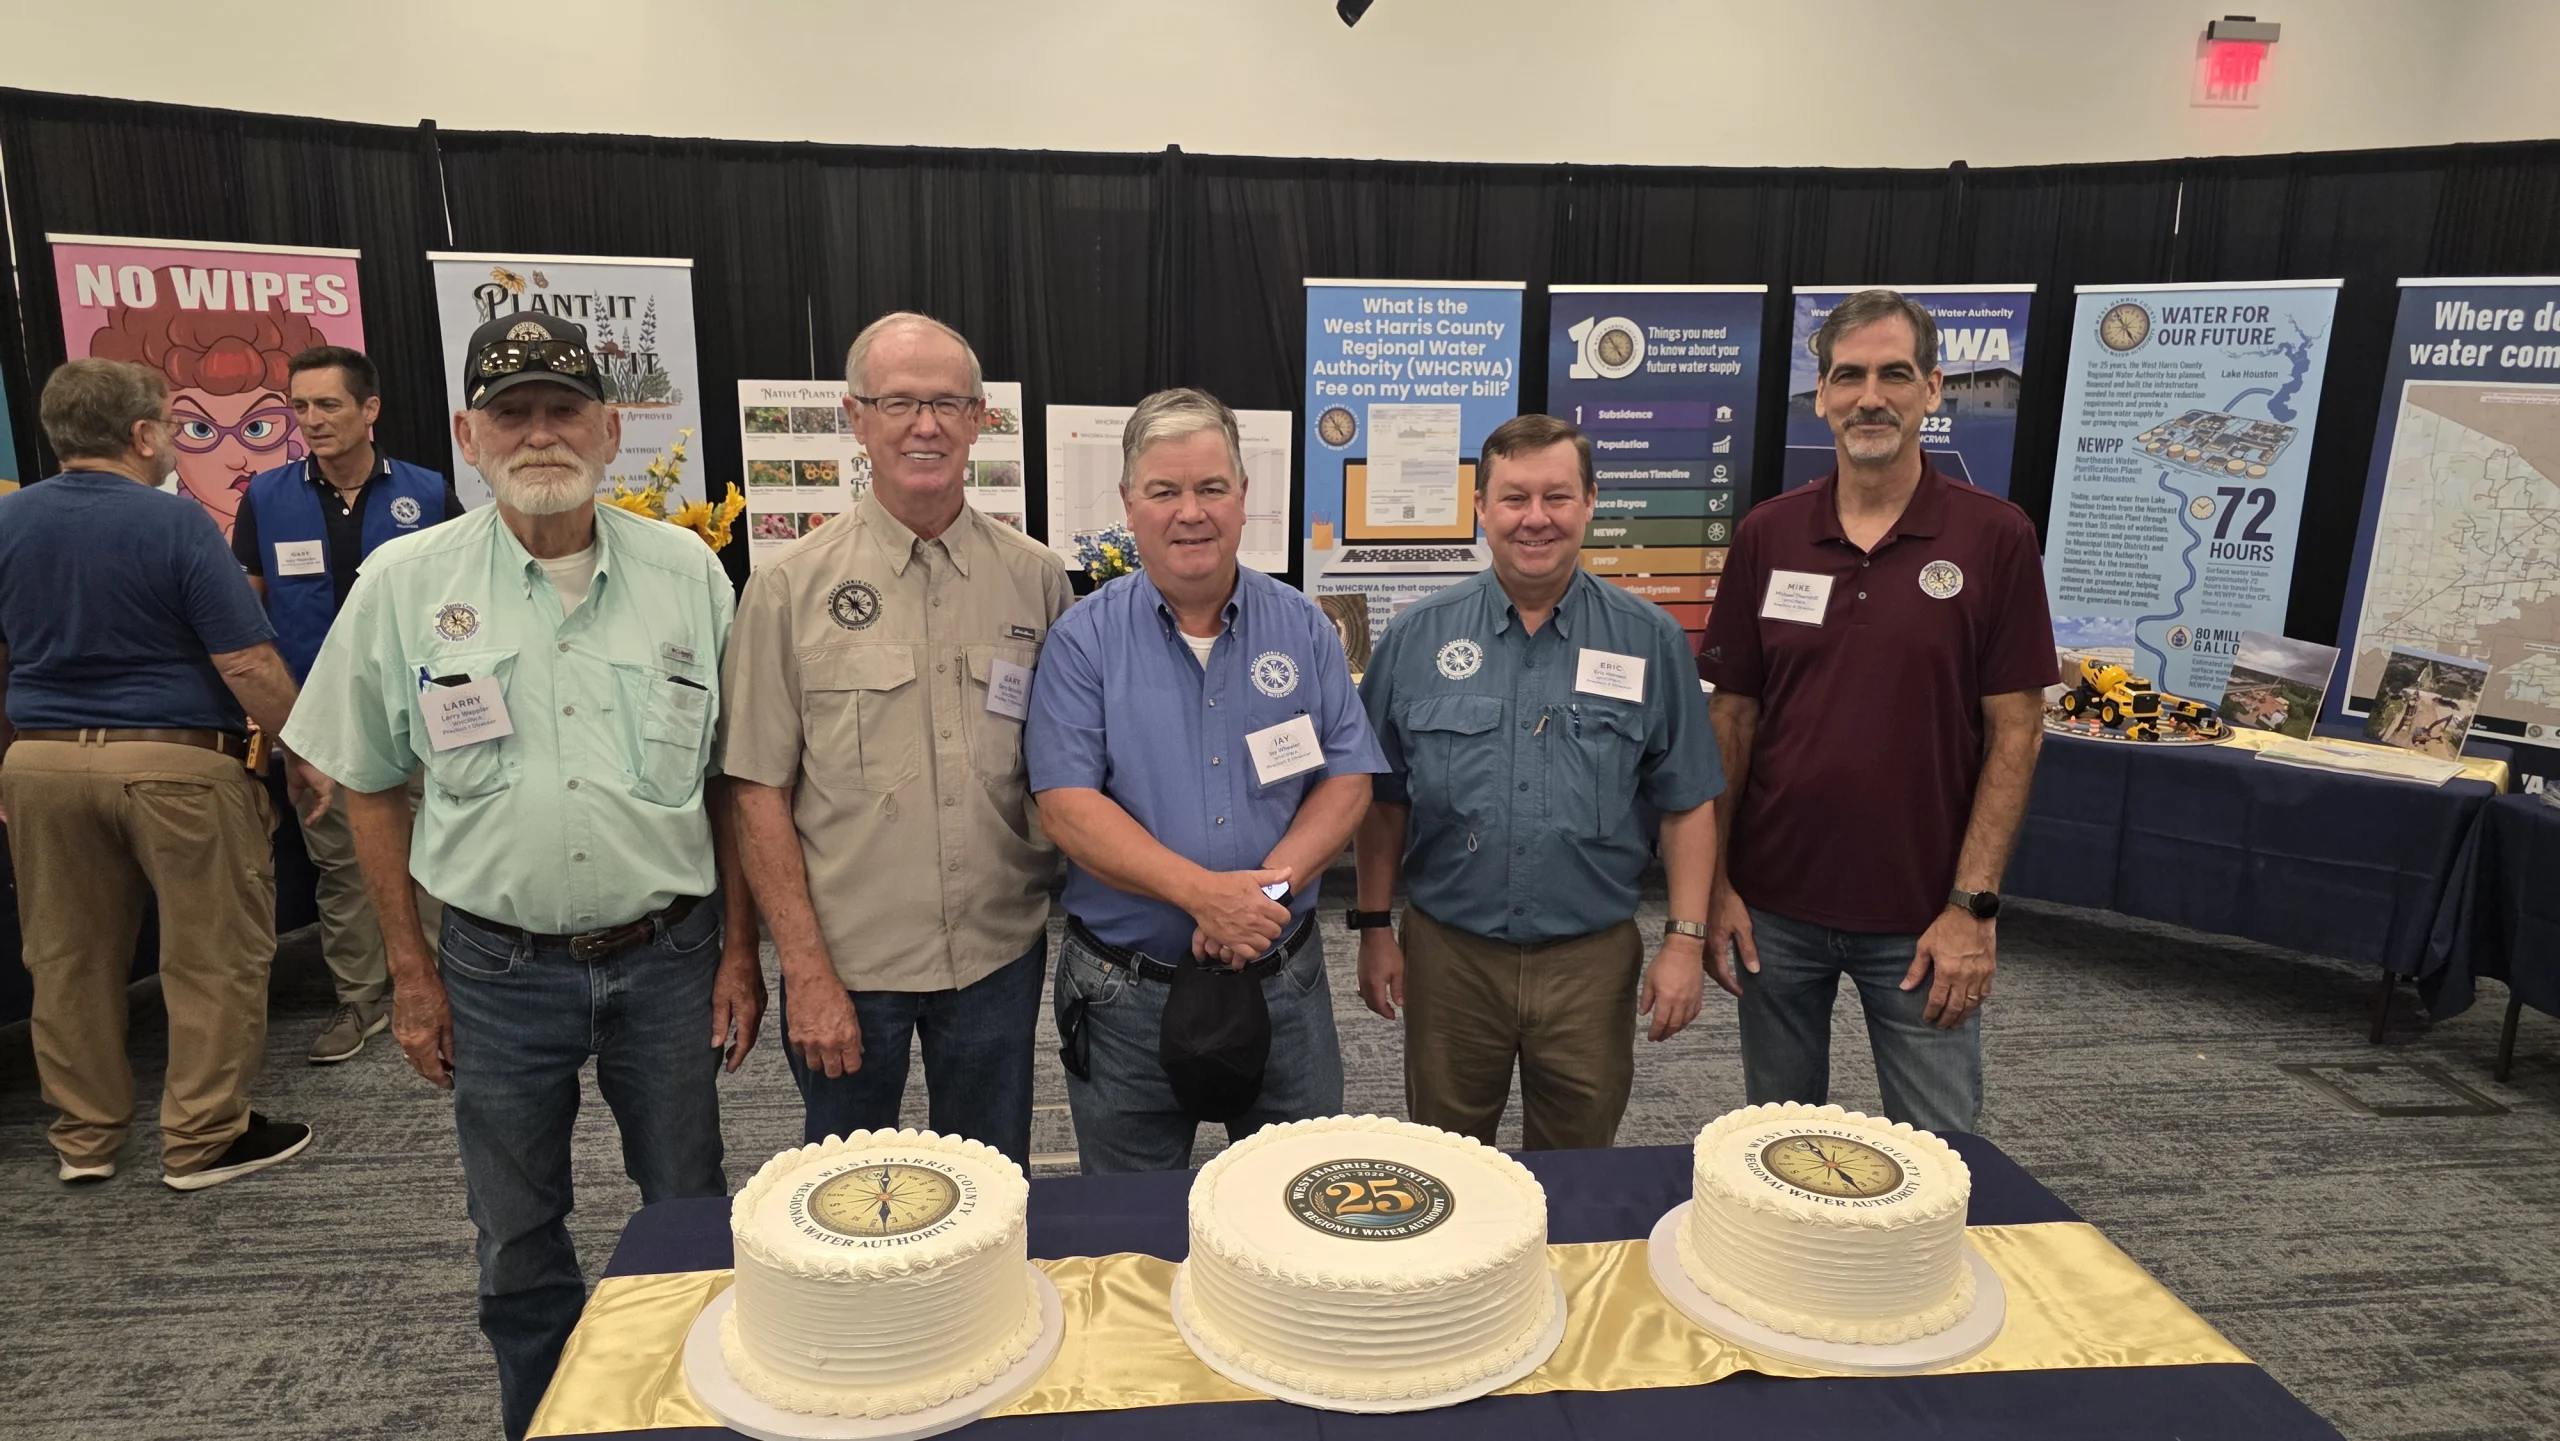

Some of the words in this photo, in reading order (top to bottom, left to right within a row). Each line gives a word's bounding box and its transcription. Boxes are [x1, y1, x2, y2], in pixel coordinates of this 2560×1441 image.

[75, 264, 157, 309] NO
[169, 267, 349, 316] WIPES
[473, 283, 592, 320] PLANT
[606, 295, 636, 319] IT
[1363, 298, 1414, 314] What
[1418, 297, 1433, 314] is
[1437, 299, 1468, 314] the
[1811, 309, 1832, 317] Wes
[1937, 309, 1966, 317] Water
[1968, 309, 2013, 319] Authority
[2162, 307, 2227, 324] WATER
[2232, 306, 2269, 323] FOR
[2435, 301, 2524, 331] Where
[1324, 318, 1372, 334] West
[1376, 318, 1432, 335] Harris
[1436, 320, 1504, 340] County
[1648, 327, 1680, 342] Things
[1683, 328, 1699, 342] you
[1702, 327, 1726, 339] need
[2158, 328, 2196, 346] OUR
[2201, 327, 2276, 345] FUTURE
[1342, 339, 1424, 360] Regional
[1429, 340, 1486, 356] Water
[1568, 316, 1645, 379] 10
[1648, 344, 1658, 356] to
[1660, 344, 1686, 356] know
[1688, 344, 1716, 356] about
[1718, 346, 1739, 358] your
[2410, 339, 2492, 367] water
[629, 353, 658, 375] IT
[1313, 359, 1402, 380] Authority
[1407, 357, 1512, 380] (WHCRWA)
[1647, 361, 1676, 373] future
[1679, 362, 1707, 373] water
[1709, 361, 1741, 375] supply
[2100, 361, 2108, 369] 25
[2110, 362, 2127, 370] years,
[2141, 361, 2157, 369] West
[2159, 361, 2178, 369] Harris
[2180, 362, 2202, 370] County
[2087, 371, 2113, 379] Regional
[2135, 371, 2164, 379] Authority
[2221, 370, 2241, 378] Lake
[2243, 370, 2278, 379] Houston
[761, 388, 798, 400] NATIVE
[798, 388, 836, 400] PLANTS
[1316, 380, 1348, 396] Fee
[1352, 383, 1375, 396] on
[1380, 383, 1410, 401] my
[1414, 381, 1468, 396] water
[1472, 381, 1510, 396] bill?
[2133, 391, 2172, 399] groundwater
[2138, 401, 2161, 409] provide
[1575, 406, 1582, 425] 1
[1599, 410, 1653, 419] Subsidence
[2133, 410, 2153, 418] supply
[1597, 440, 1649, 450] Population
[2077, 436, 2123, 453] NEWPP
[2076, 456, 2113, 464] Northeast
[2116, 457, 2138, 465] Water
[1596, 470, 1649, 479] Conversion
[1650, 470, 1690, 479] Timeline
[2074, 465, 2118, 473] Purification
[1595, 499, 1615, 508] Luce
[1617, 500, 1647, 510] Bayou
[2151, 496, 2165, 504] Lake
[2213, 487, 2276, 542] 72
[1593, 528, 1627, 537] NEWPP
[2209, 542, 2274, 562] HOURS
[1592, 557, 1618, 565] SWSP
[1647, 585, 1680, 595] System
[1788, 583, 1811, 592] MIKE
[2196, 628, 2210, 640] 80
[2213, 629, 2244, 642] MILL
[2194, 640, 2239, 655] GALLO
[1600, 662, 1622, 671] ERIC
[1004, 675, 1021, 685] GARY
[443, 696, 481, 711] LARRY
[441, 712, 460, 722] Larry
[462, 706, 489, 717] Weppler
[1273, 735, 1289, 747] JAY
[1278, 742, 1300, 753] Wheeler
[1748, 1132, 1783, 1148] WEST
[1789, 1128, 1865, 1141] HARRIS
[1872, 1141, 1921, 1178] COUNTY
[1293, 1176, 1314, 1200] WEST
[1311, 1162, 1370, 1178] HARRIS
[1374, 1163, 1434, 1187] COUNTY
[1327, 1171, 1384, 1182] 2001-2026
[1744, 1152, 1785, 1191] REGIONAL
[1789, 1189, 1848, 1207] WATER
[1851, 1180, 1921, 1208] AUTHORITY
[818, 1158, 872, 1178] WEST
[883, 1157, 956, 1174] HARRIS
[955, 1173, 978, 1216] COUNTY
[1325, 1178, 1414, 1215] 25
[789, 1182, 815, 1228] REGIONAL
[802, 1225, 853, 1248] WATER
[857, 1218, 958, 1248] AUTHORITY
[1303, 1210, 1358, 1235] REGIONAL
[1362, 1227, 1408, 1237] WATER
[1409, 1197, 1445, 1232] AUTHORITY
